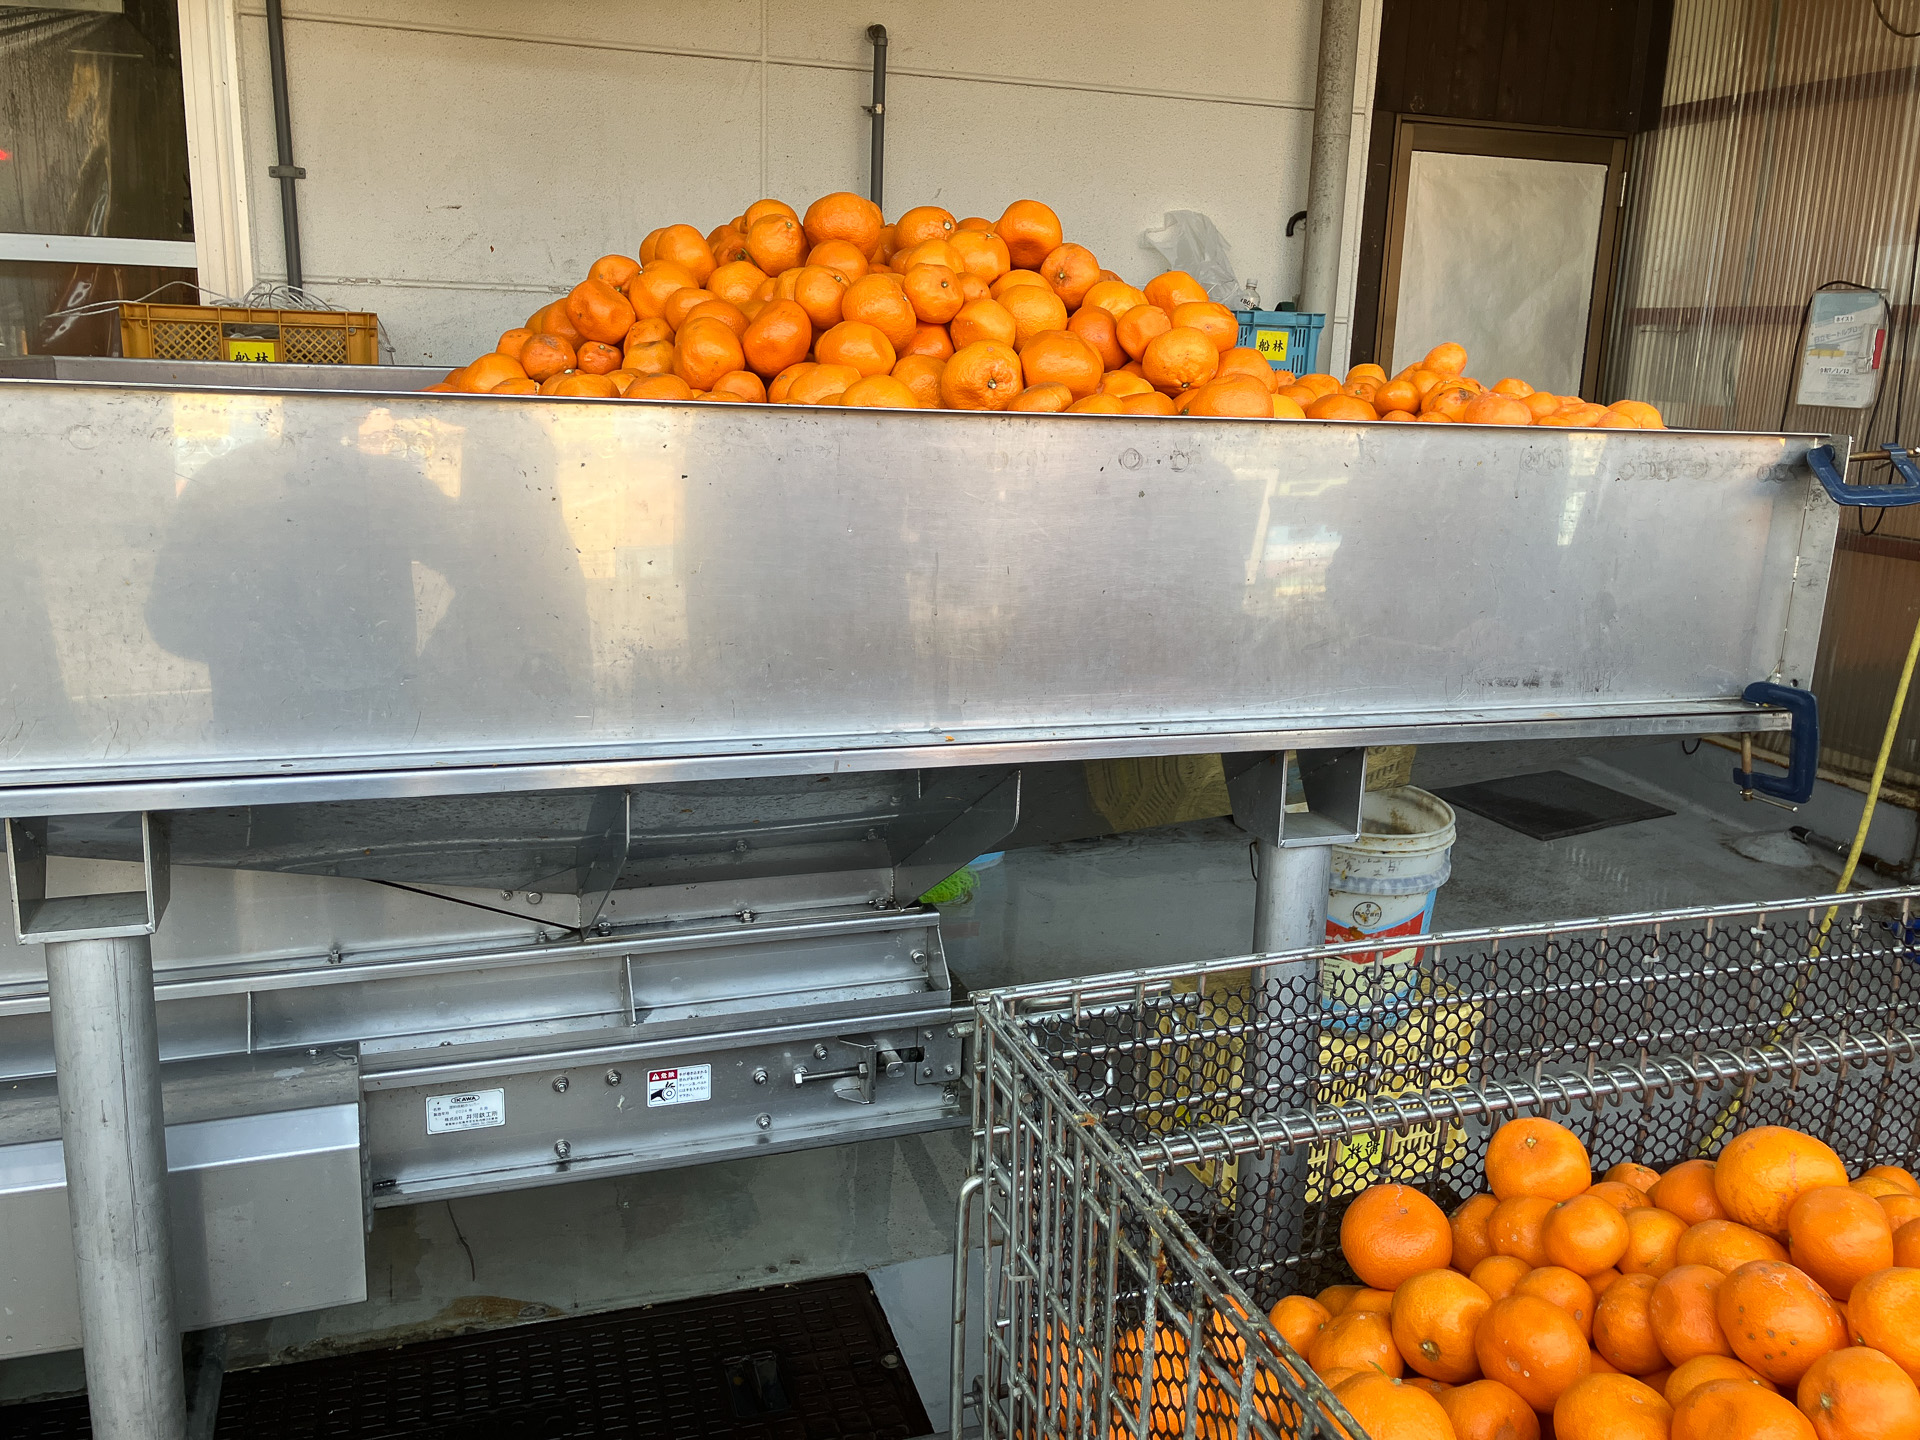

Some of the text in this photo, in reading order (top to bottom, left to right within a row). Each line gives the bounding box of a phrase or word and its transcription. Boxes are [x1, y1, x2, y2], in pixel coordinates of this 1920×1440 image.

[1814, 326, 1863, 342] 日立モートルブロッ
[1258, 339, 1284, 352] 船林
